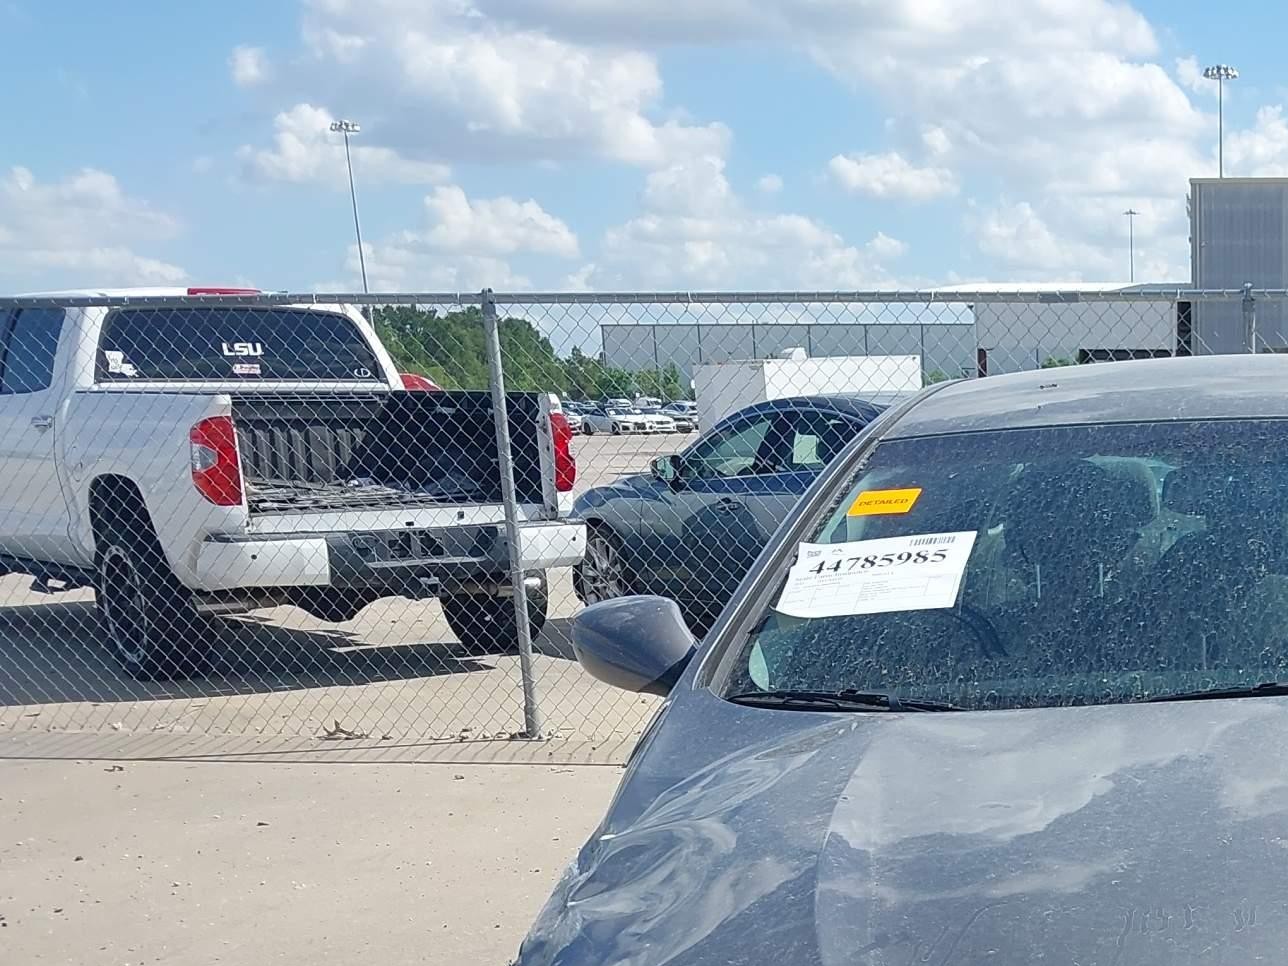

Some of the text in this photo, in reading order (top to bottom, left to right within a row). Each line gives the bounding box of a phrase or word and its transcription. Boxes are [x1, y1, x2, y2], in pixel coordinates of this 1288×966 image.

[221, 342, 264, 356] LSU
[858, 498, 909, 507] DETAILED
[809, 549, 949, 575] 44785985
